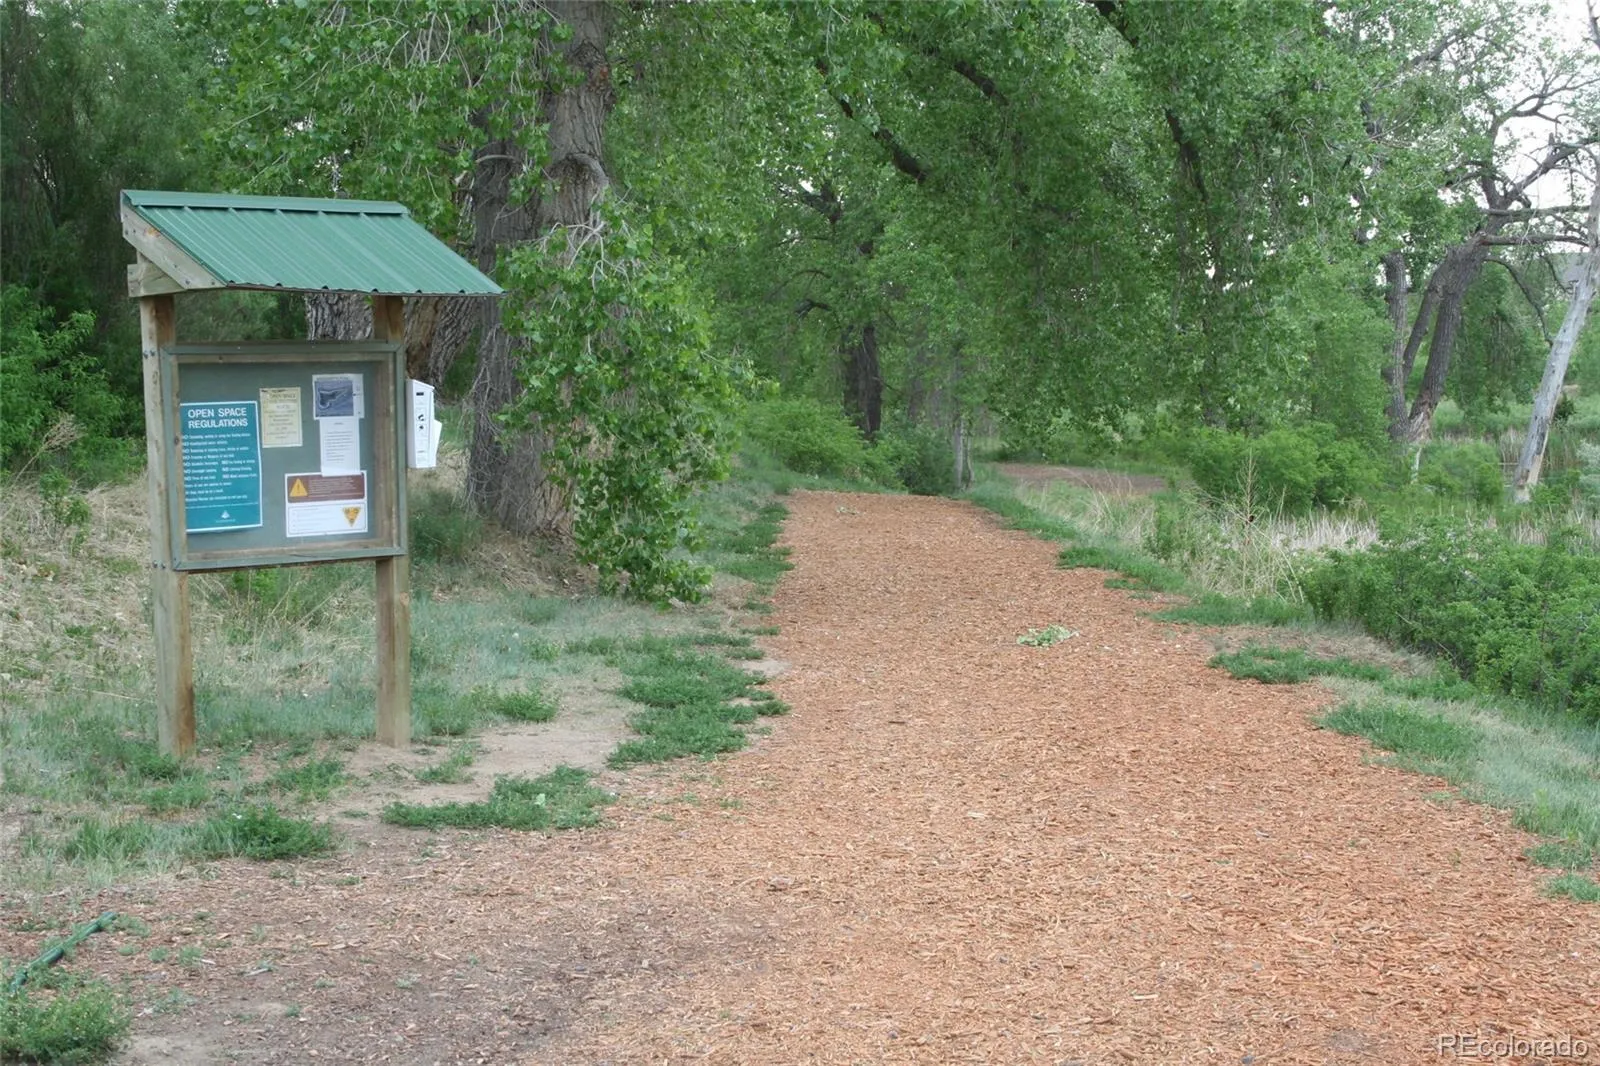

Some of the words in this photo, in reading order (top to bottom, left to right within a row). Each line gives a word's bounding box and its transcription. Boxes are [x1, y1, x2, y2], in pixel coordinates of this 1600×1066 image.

[187, 408, 214, 419] OPEN
[218, 407, 247, 417] SPACE
[187, 418, 248, 429] REGULATIONS
